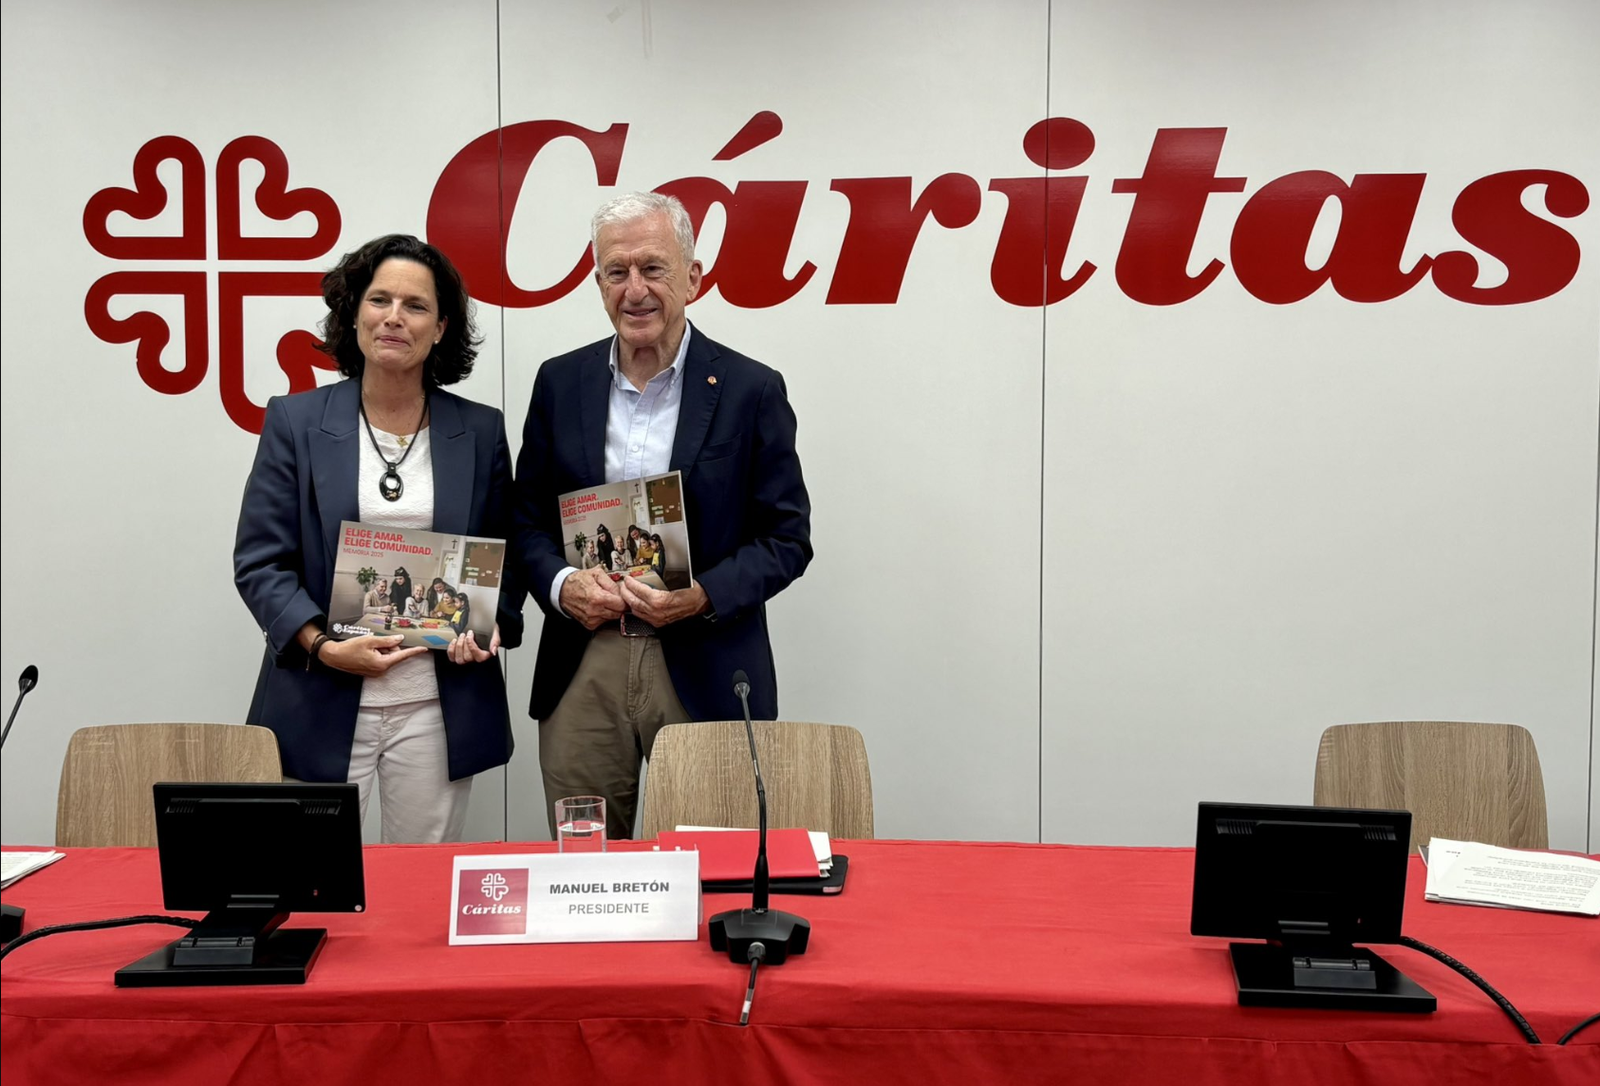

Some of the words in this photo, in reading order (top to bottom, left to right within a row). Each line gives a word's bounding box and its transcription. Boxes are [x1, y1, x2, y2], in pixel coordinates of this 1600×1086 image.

[426, 110, 1590, 308] Cáritas
[561, 497, 576, 509] ELIGE
[577, 493, 599, 504] AMAR.
[562, 507, 577, 518] ELIGE
[577, 497, 623, 514] COMUNIDAD.
[345, 527, 373, 539] ELIGE
[373, 531, 405, 543] AMAR.
[342, 547, 370, 556] MEMORIA
[344, 537, 371, 549] ELIGE
[373, 540, 433, 556] COMUNIDAD.
[549, 882, 608, 895] MANUEL
[612, 879, 670, 893] BRETÓN
[462, 903, 522, 915] Cáritas
[568, 902, 650, 915] PRESIDENTE
